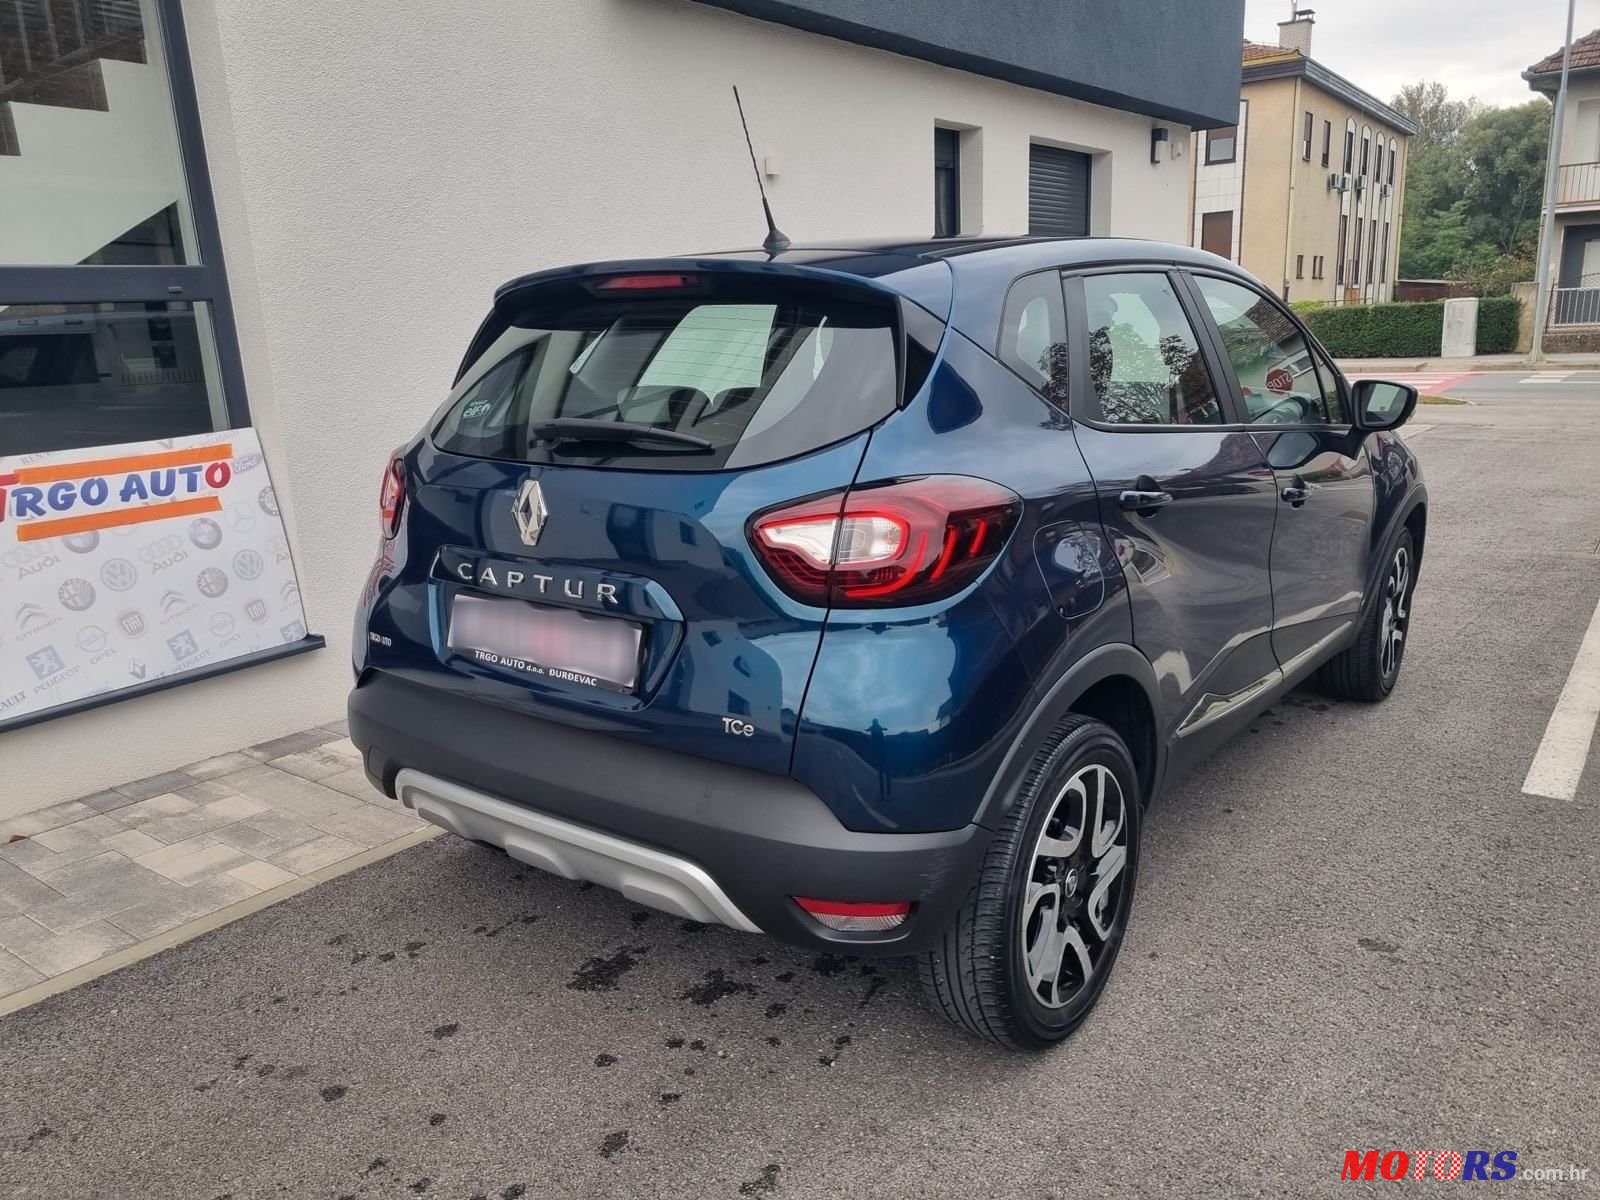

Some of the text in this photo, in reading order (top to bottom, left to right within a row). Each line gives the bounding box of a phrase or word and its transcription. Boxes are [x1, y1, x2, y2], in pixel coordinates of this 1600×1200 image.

[119, 462, 231, 503] AUTO
[457, 562, 619, 604] CAPTUR
[474, 650, 498, 663] TRGO
[500, 656, 525, 669] AUTO
[526, 664, 545, 675] d.o.o.
[722, 717, 754, 737] TCe
